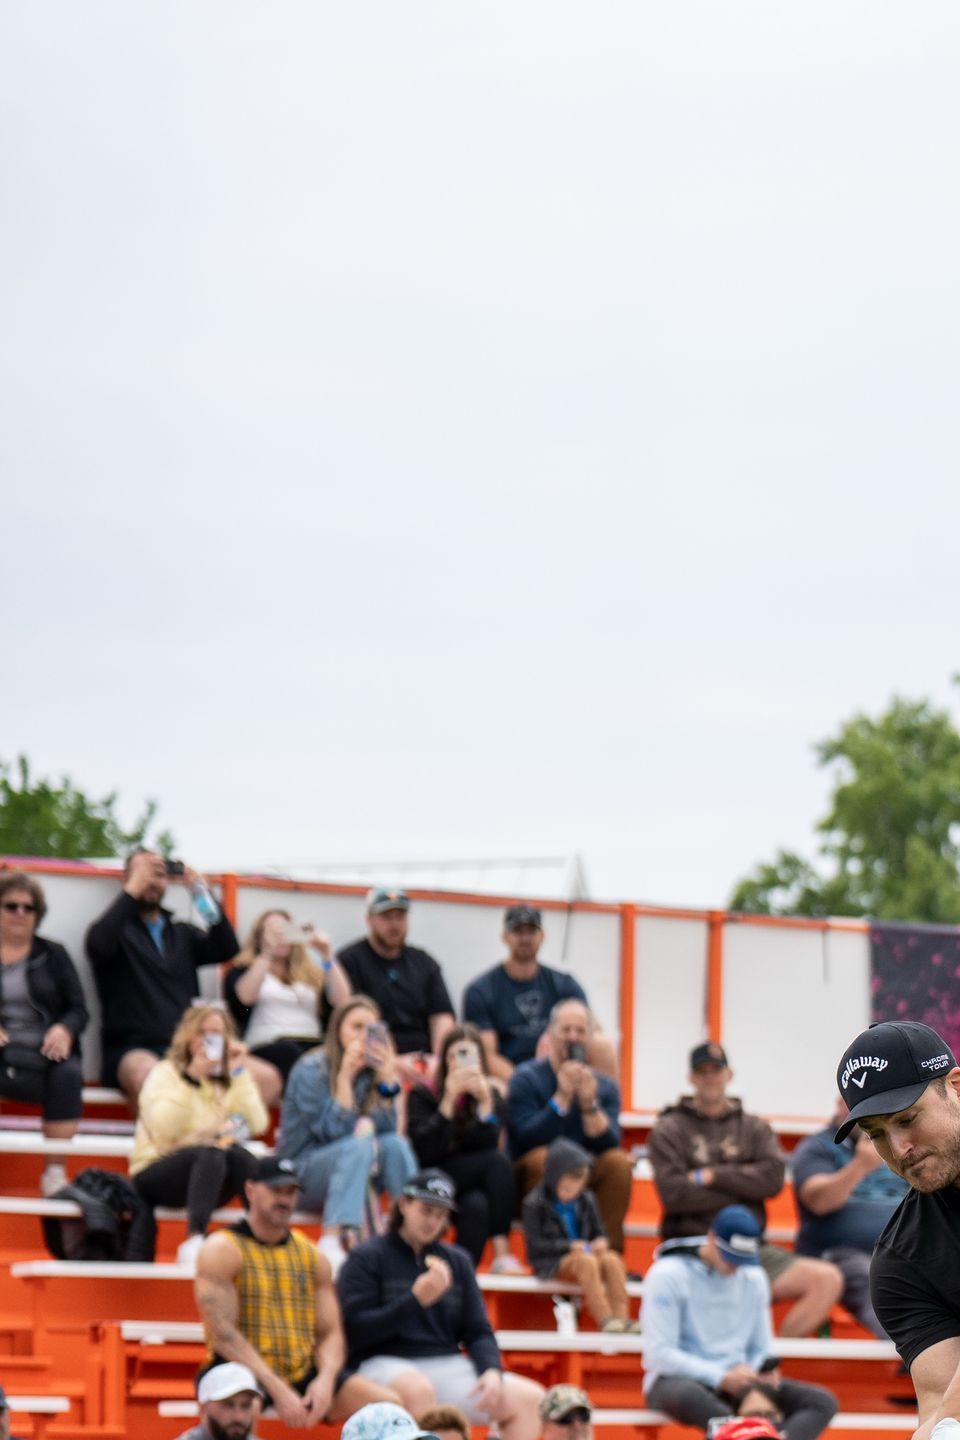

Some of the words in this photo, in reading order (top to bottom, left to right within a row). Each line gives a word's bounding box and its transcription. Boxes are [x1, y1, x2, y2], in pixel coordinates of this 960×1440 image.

[920, 1053, 949, 1068] CHROME
[929, 1060, 949, 1072] TOUR
[841, 1056, 888, 1089] Callaway
